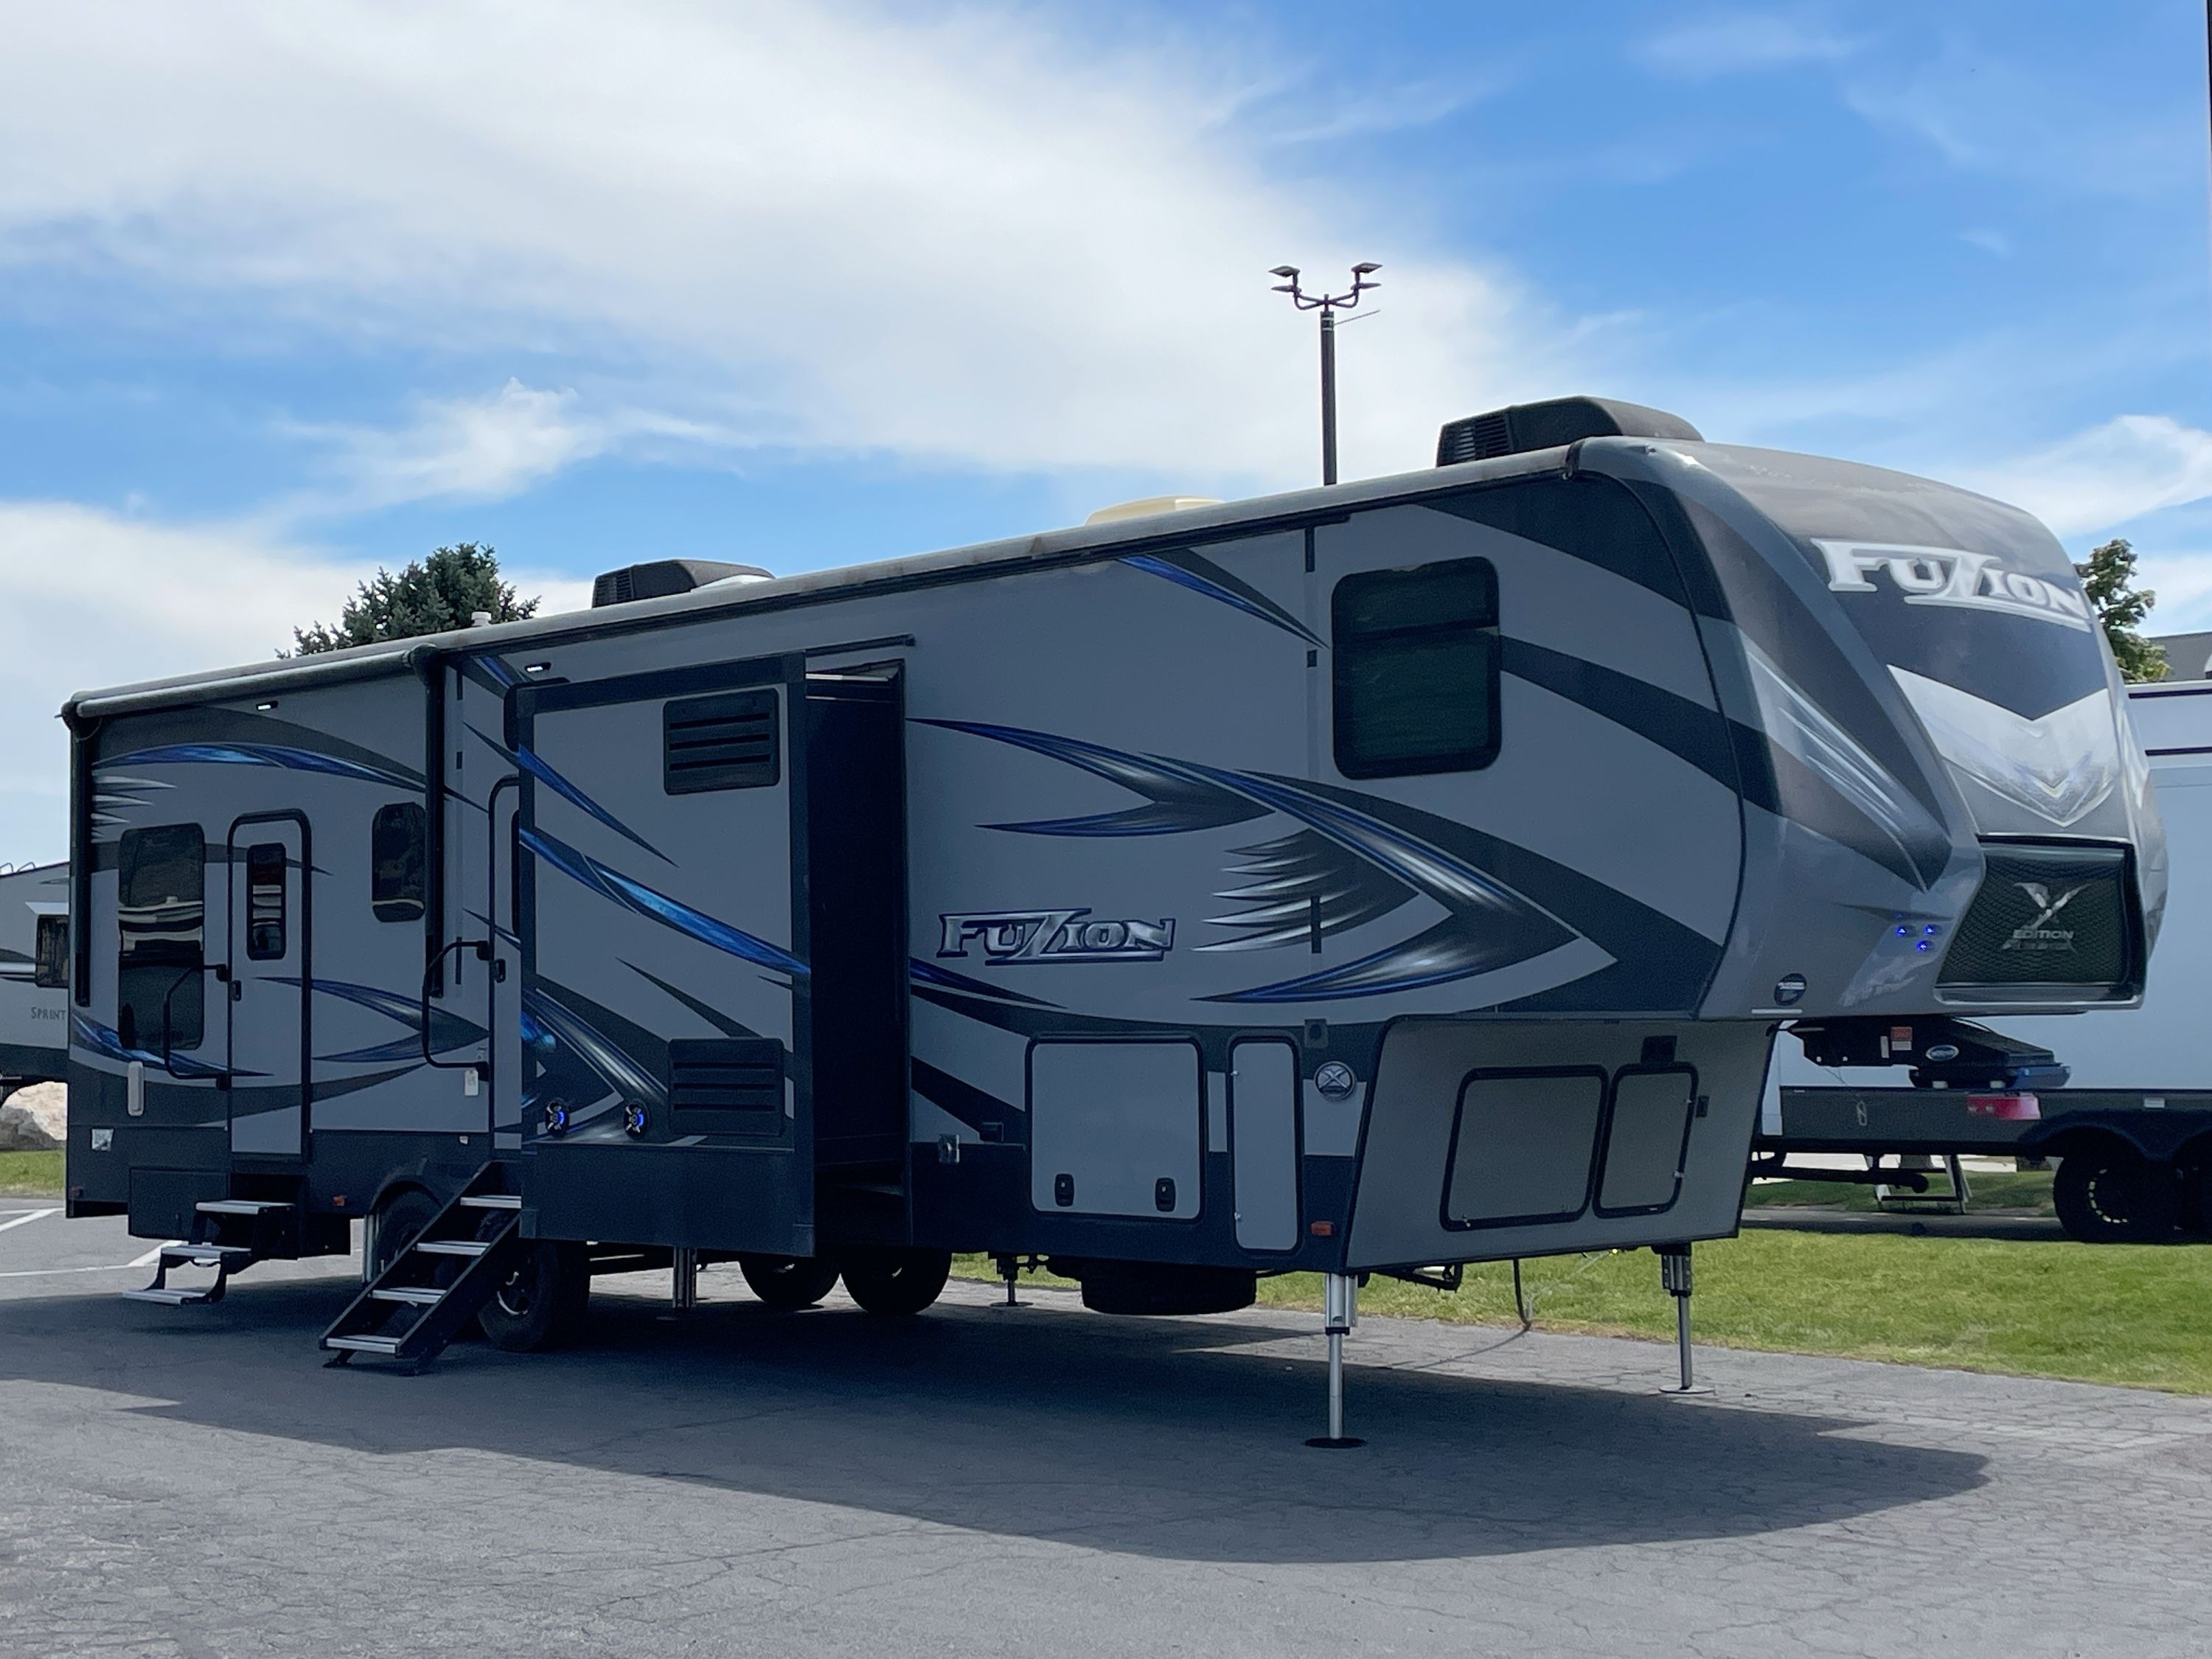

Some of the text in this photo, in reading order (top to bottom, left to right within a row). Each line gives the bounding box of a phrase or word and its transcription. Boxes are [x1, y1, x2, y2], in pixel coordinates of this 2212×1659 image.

[1810, 538, 2092, 633] FUZION
[936, 908, 1176, 966] FUZION
[2013, 929, 2075, 939] EDITION
